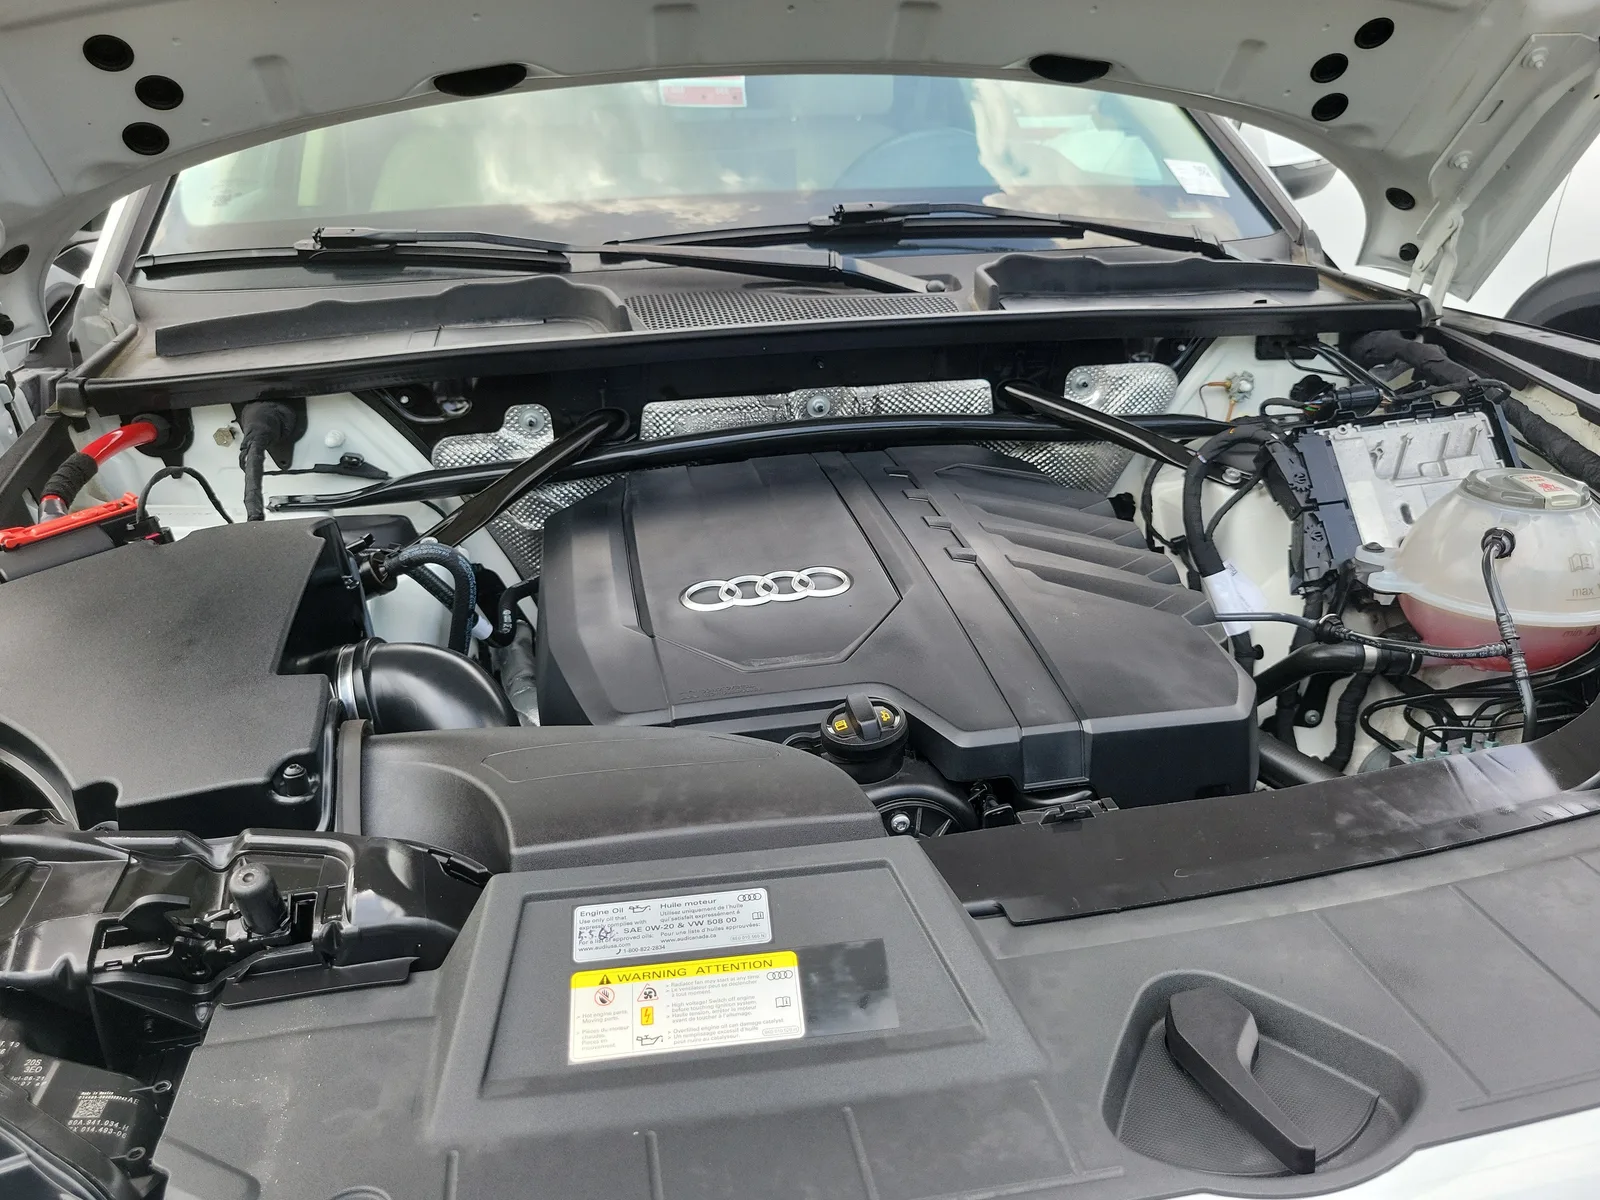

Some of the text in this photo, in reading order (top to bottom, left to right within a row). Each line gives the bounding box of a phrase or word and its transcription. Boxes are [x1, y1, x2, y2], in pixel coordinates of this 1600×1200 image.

[1572, 587, 1594, 597] max
[1562, 629, 1583, 638] min
[685, 899, 717, 907] moteur
[580, 909, 609, 918] Engine
[659, 909, 681, 917] Utilisez
[682, 905, 716, 914] uniquement
[579, 923, 606, 932] expressly
[608, 920, 633, 929] complies
[623, 926, 643, 934] SAE
[645, 923, 675, 932] 0W-20
[707, 918, 724, 926] 508
[613, 934, 641, 943] approved
[660, 933, 717, 944] www.audicanada.ca
[578, 942, 631, 952] www.audiusa.com
[623, 945, 666, 954] 1-800-822-2834
[617, 960, 773, 983] WARNING ATTENTION
